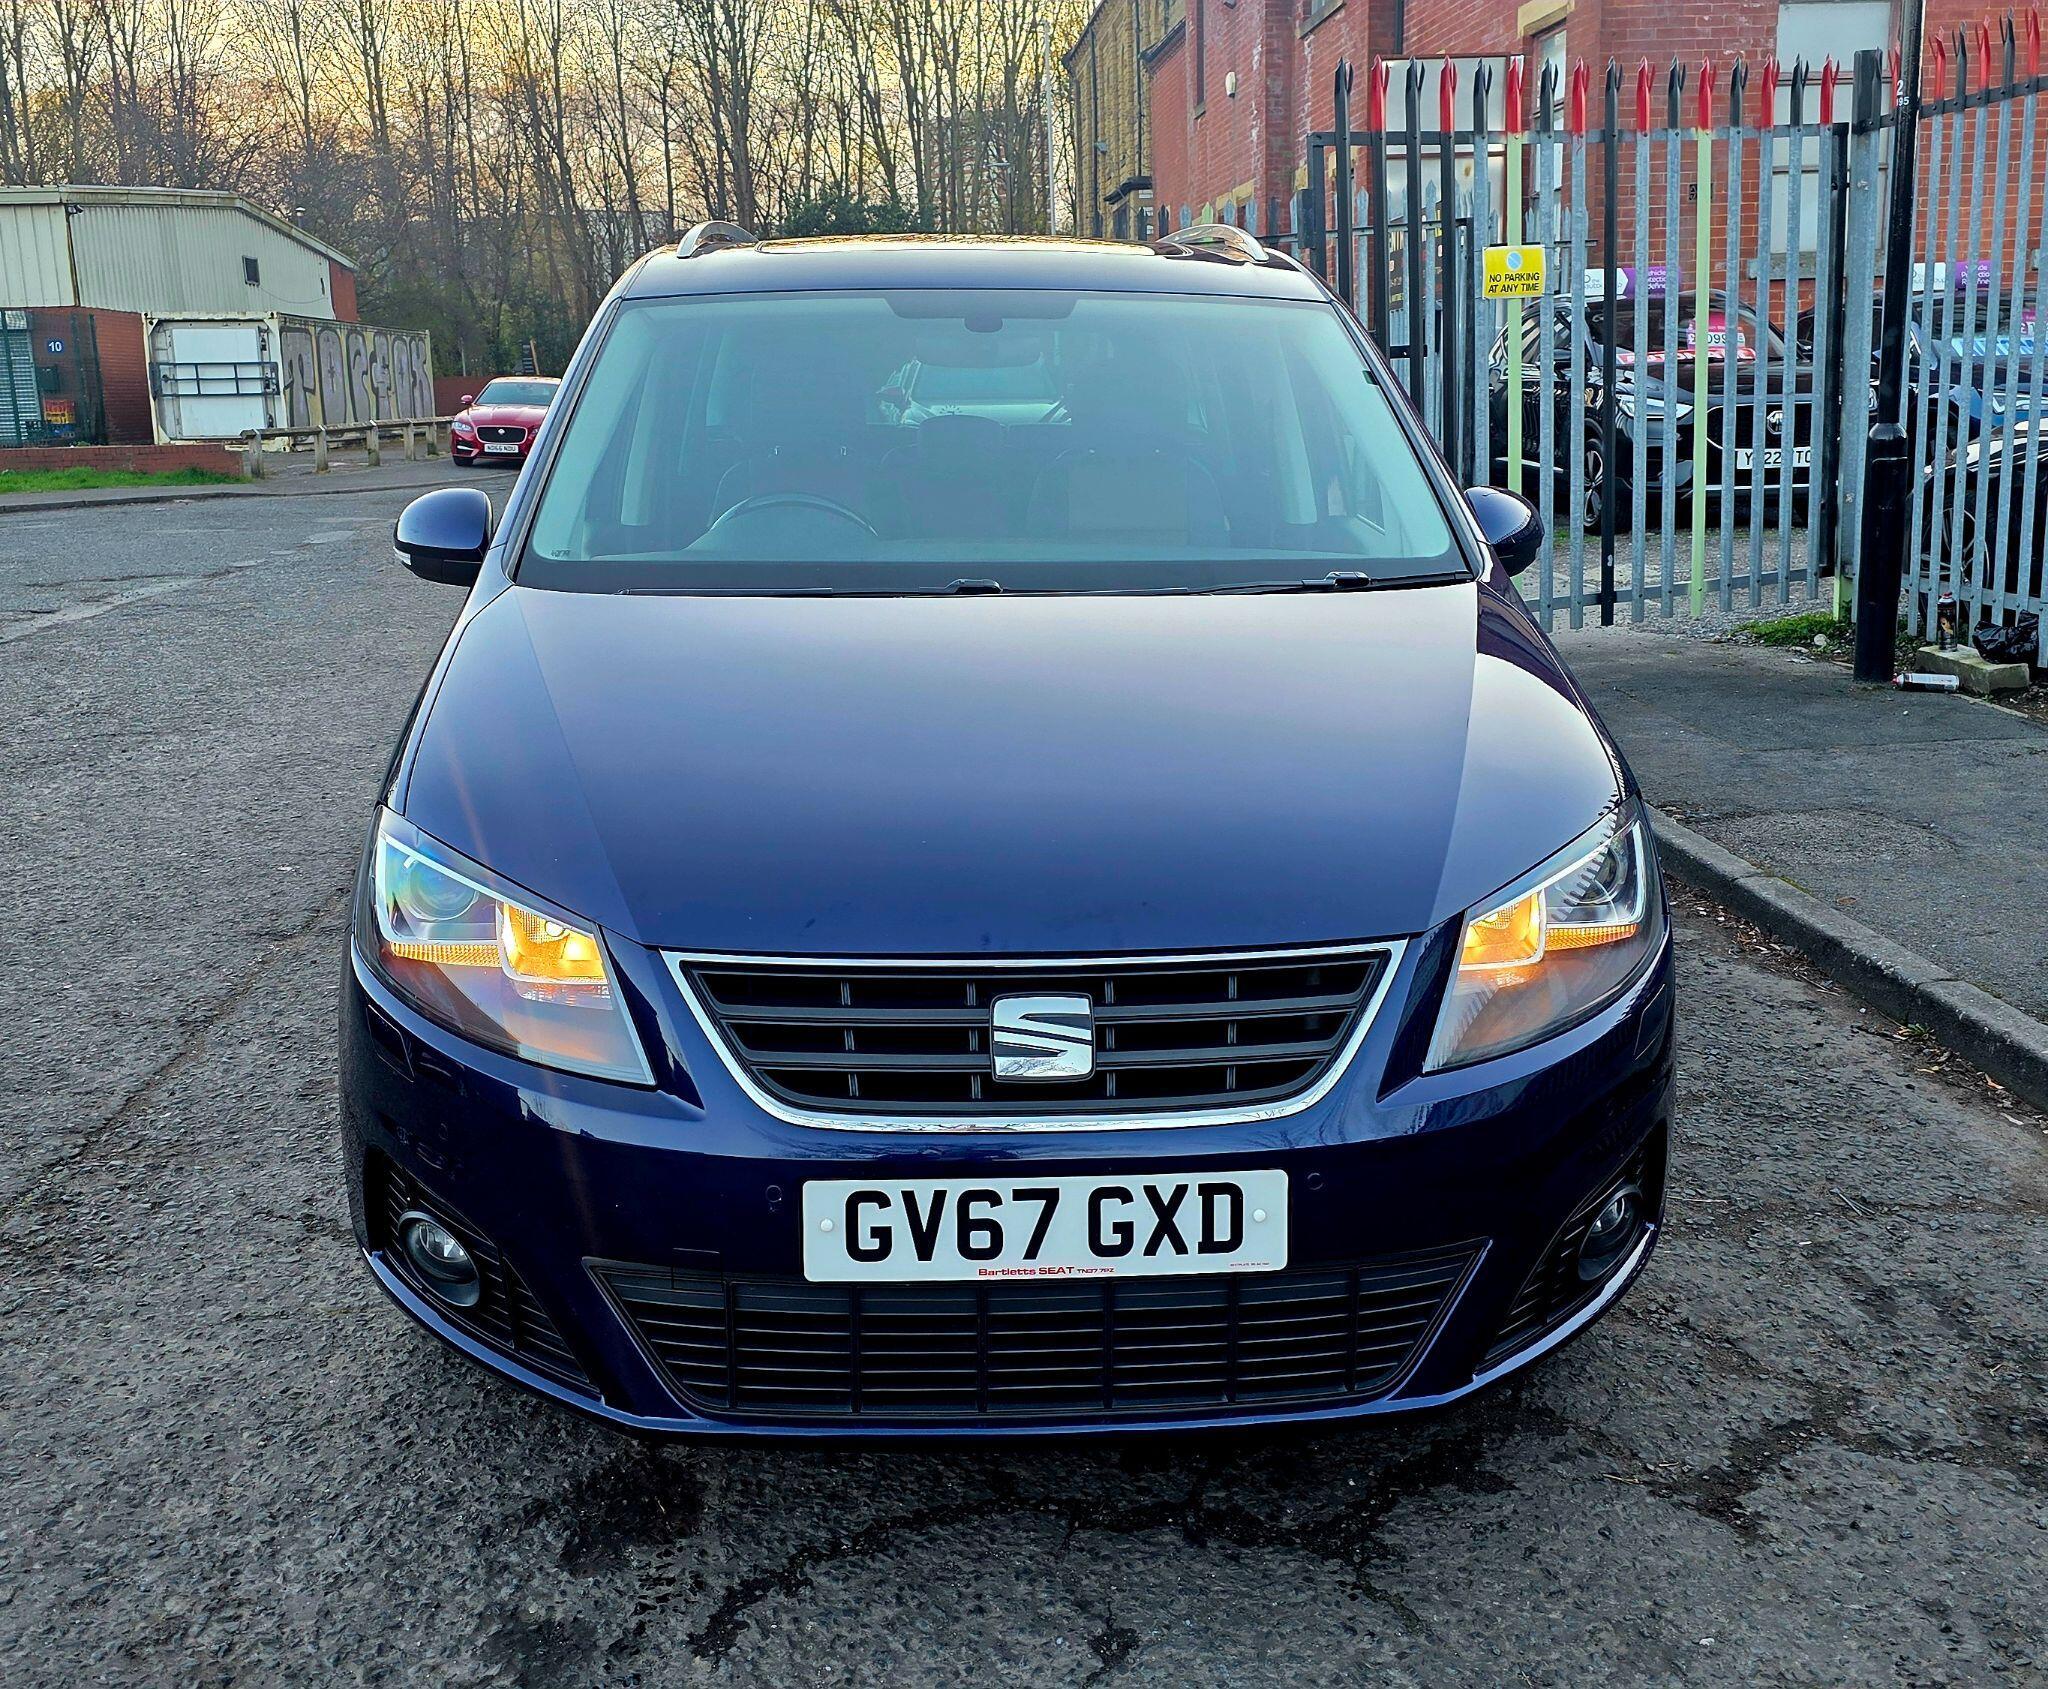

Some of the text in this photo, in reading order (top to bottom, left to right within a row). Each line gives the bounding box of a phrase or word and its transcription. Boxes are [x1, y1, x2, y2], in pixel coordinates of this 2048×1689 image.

[1489, 272, 1540, 283] NO PARKING
[1488, 283, 1539, 293] AT ANY TIME
[49, 341, 62, 352] 10
[1744, 449, 1782, 465] Y22
[845, 1181, 1244, 1263] GV67 GXD
[978, 1268, 1036, 1276] Bartletts
[1038, 1266, 1075, 1275] SEAT
